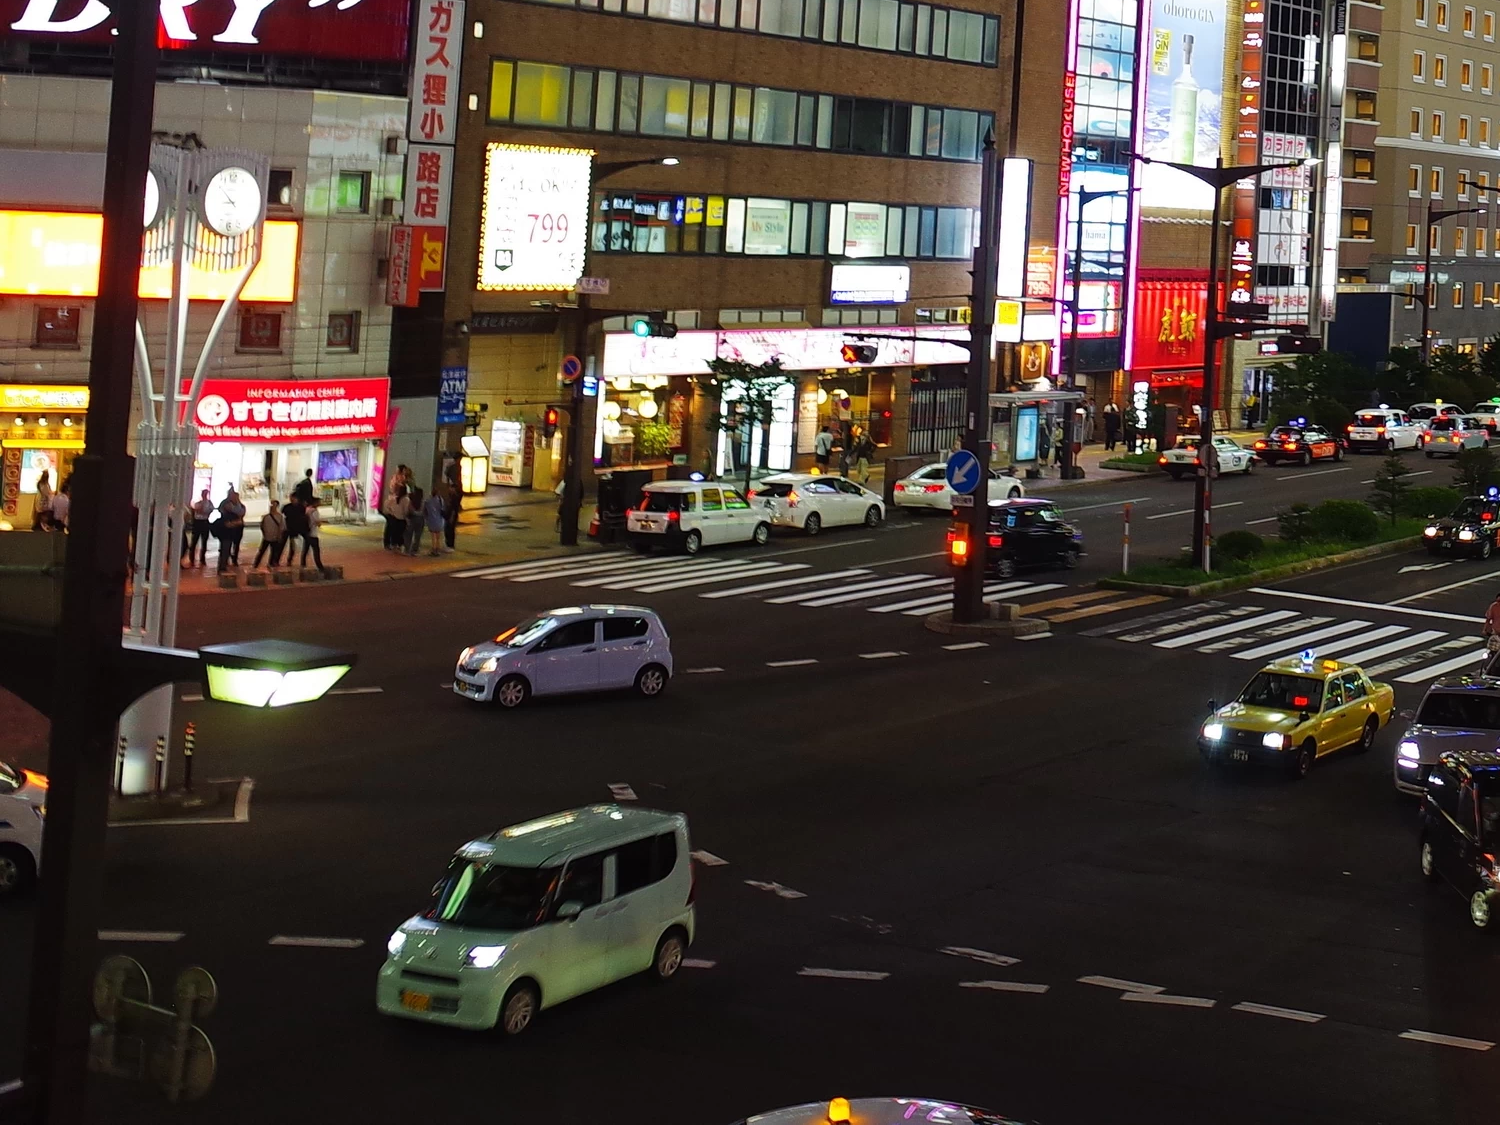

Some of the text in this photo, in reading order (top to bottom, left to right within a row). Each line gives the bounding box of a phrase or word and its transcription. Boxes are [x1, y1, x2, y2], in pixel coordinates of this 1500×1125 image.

[1264, 135, 1306, 155] カラオケ
[1059, 154, 1072, 196] NEW
[527, 213, 569, 243] 799
[441, 380, 467, 396] ATM
